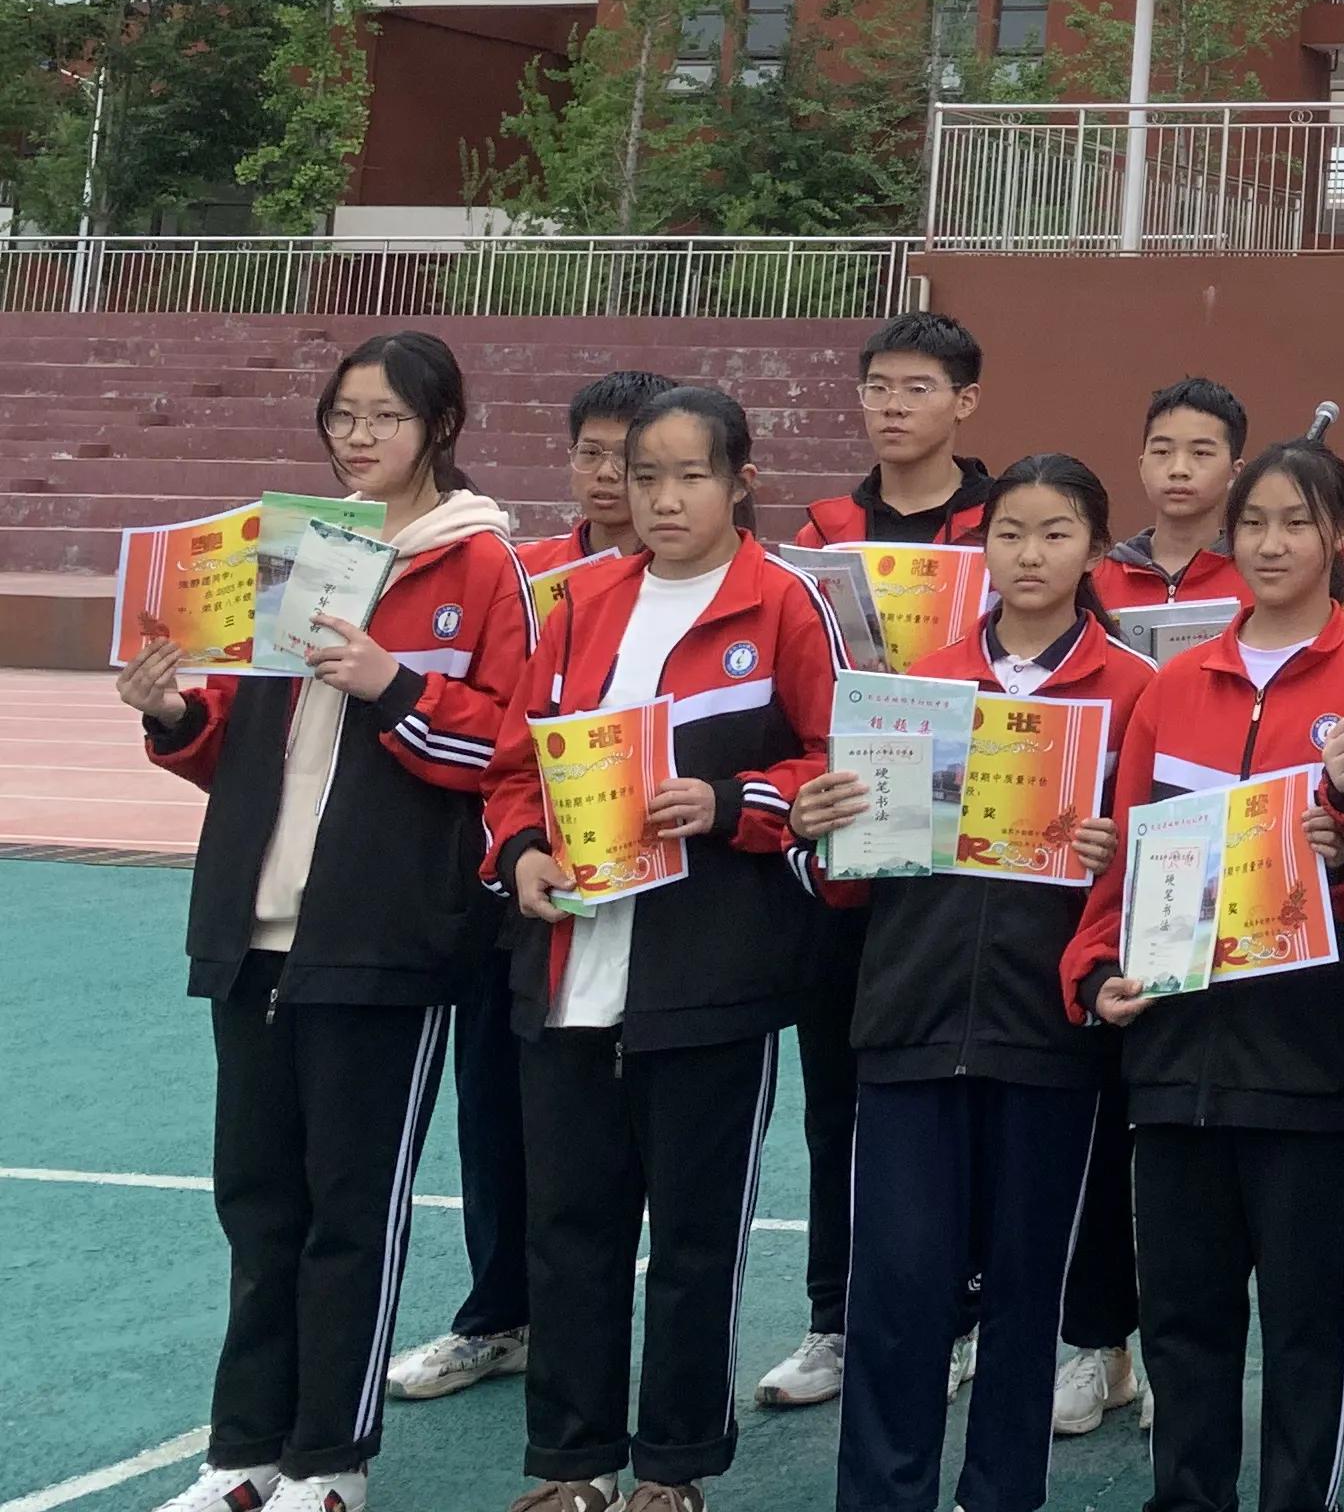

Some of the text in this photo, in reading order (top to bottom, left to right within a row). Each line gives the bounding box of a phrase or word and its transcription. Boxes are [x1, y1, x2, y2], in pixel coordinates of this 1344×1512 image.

[873, 767, 891, 822] 硬笔书法
[1159, 874, 1175, 931] 硬笔书法
